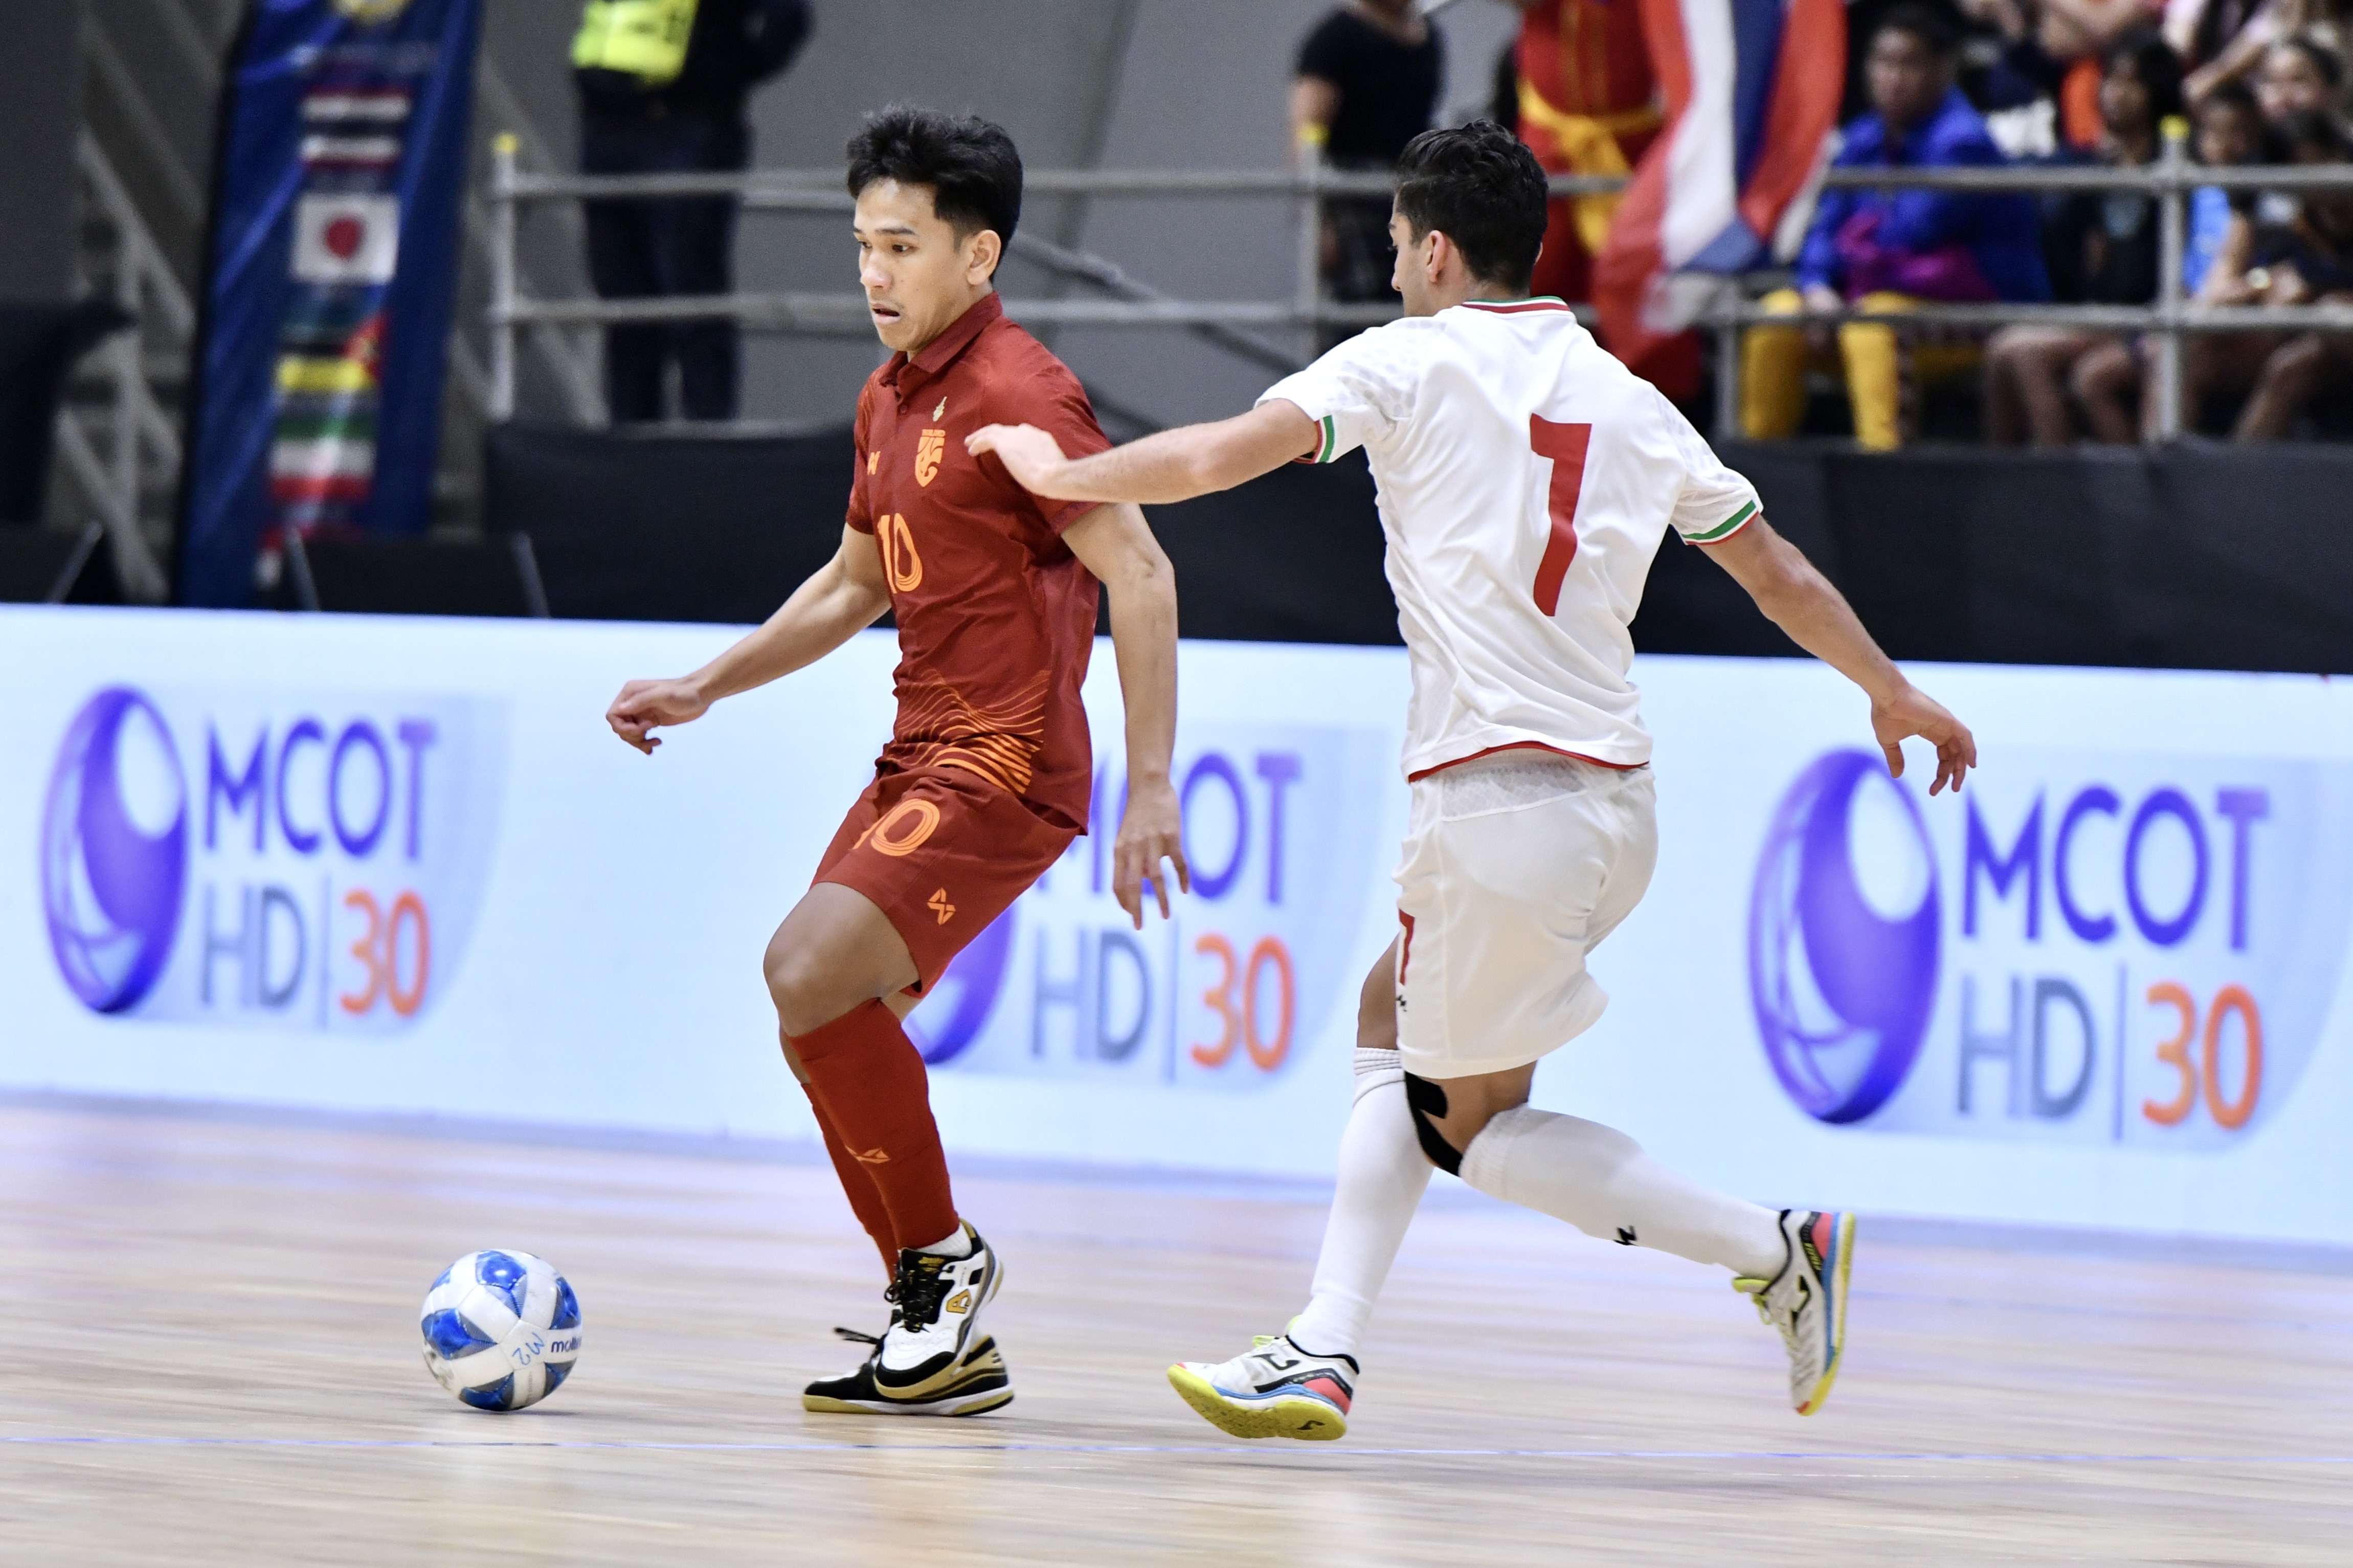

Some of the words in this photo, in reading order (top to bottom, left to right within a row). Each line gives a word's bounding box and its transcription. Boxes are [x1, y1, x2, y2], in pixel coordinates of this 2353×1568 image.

[877, 512, 923, 595] 10
[1529, 413, 1593, 617] 7
[205, 714, 439, 862] MCOT
[1960, 781, 2270, 953] MCOT
[200, 880, 307, 1009] HD
[340, 888, 432, 1017] 30
[1030, 923, 1151, 1062] HD
[1191, 931, 1295, 1073] 30
[1957, 971, 2098, 1120] HD
[2142, 981, 2265, 1130] 30
